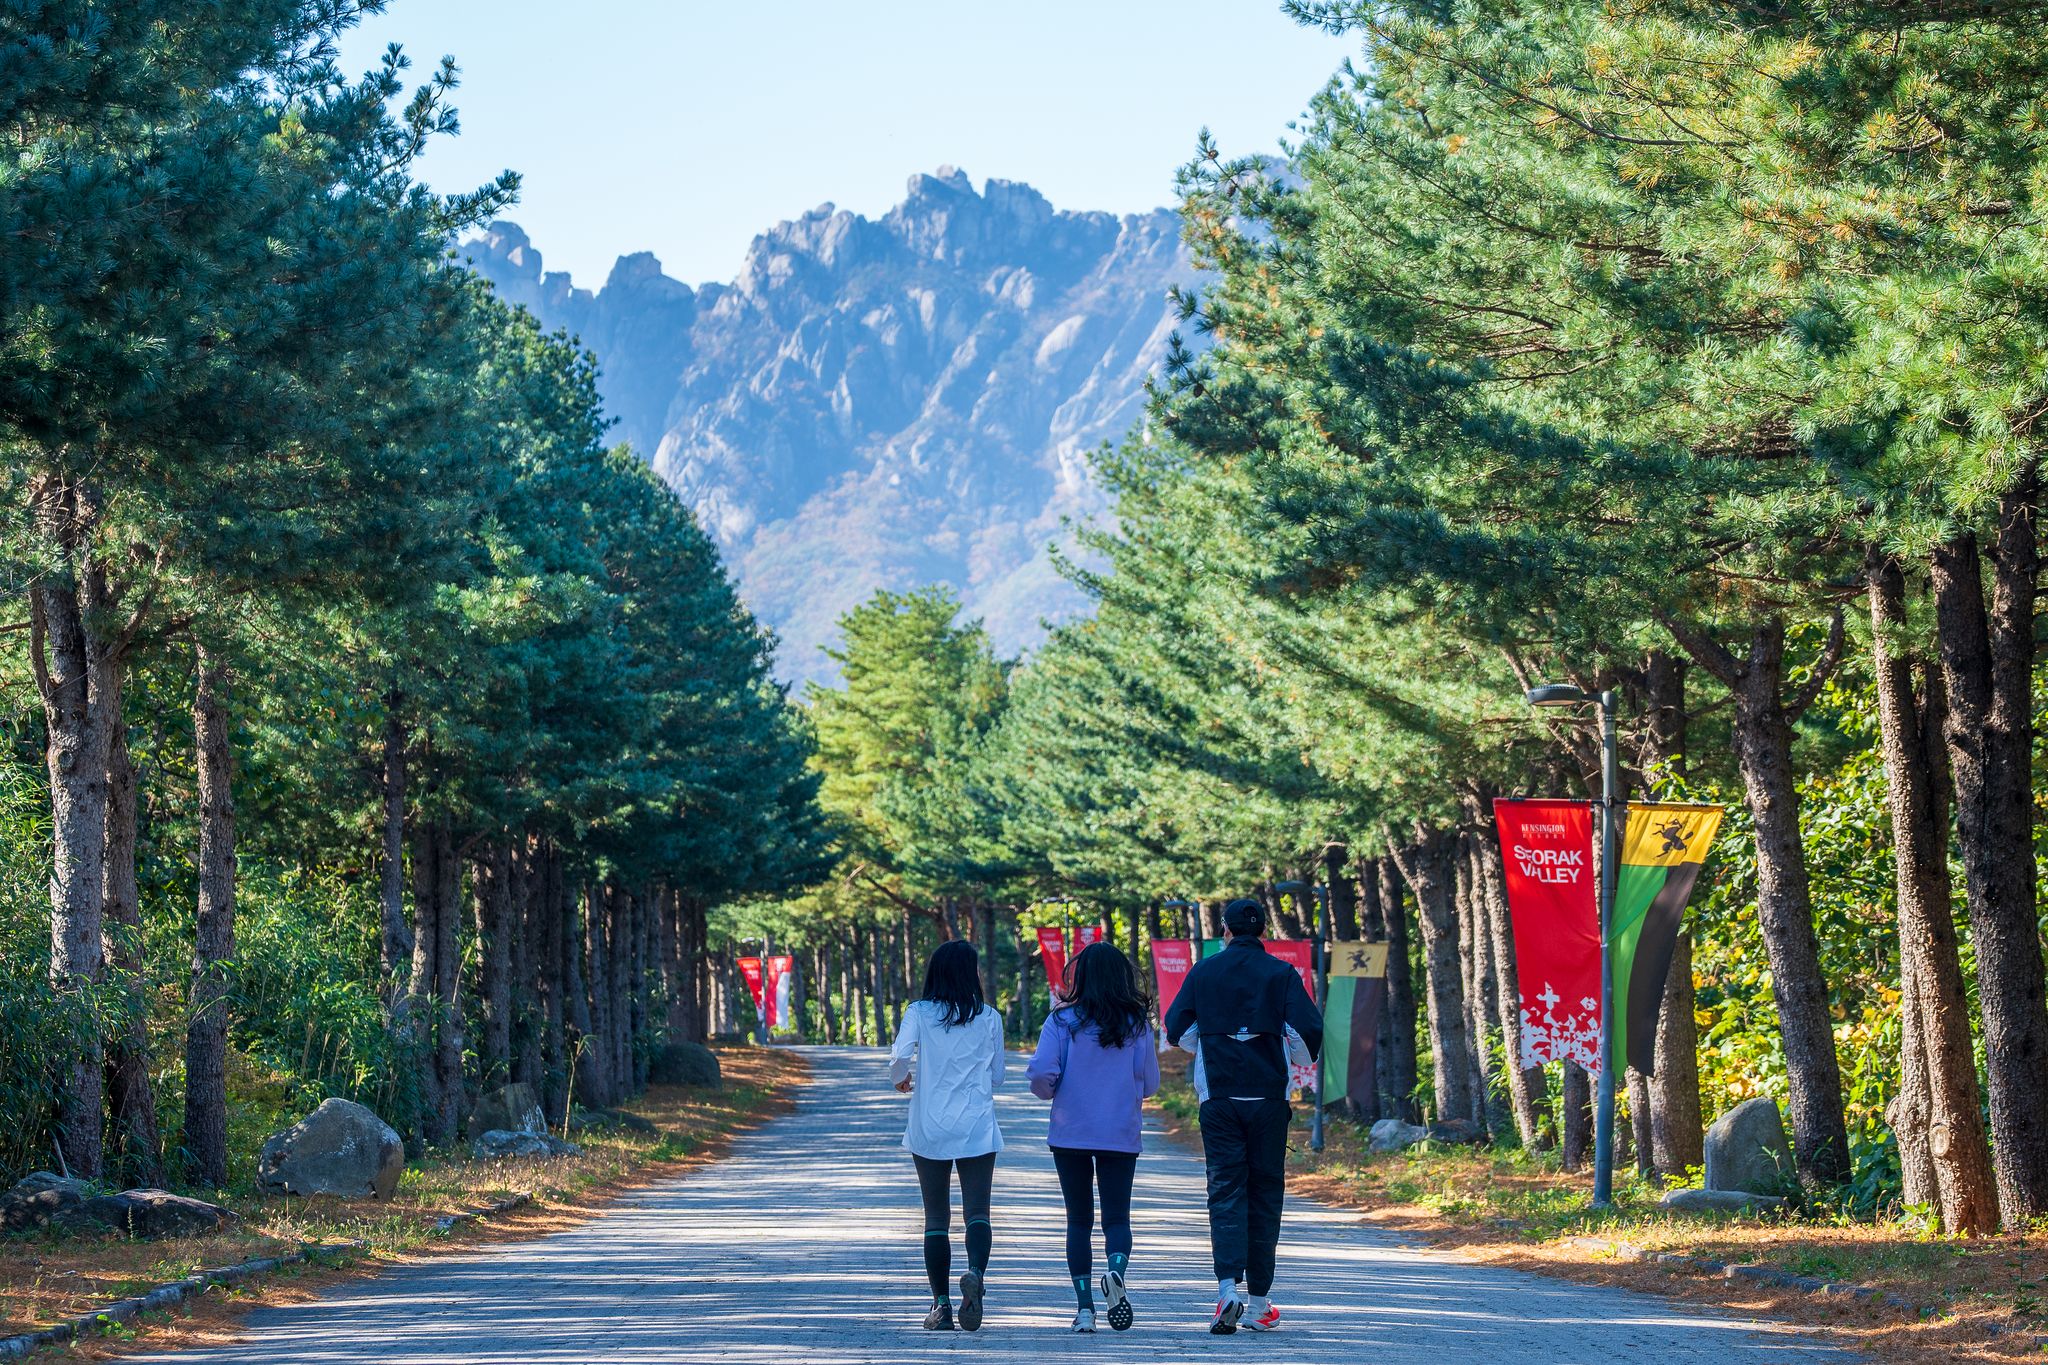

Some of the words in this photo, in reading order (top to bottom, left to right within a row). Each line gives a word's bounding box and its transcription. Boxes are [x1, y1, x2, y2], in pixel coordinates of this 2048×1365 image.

[1521, 824, 1565, 833] KENSINGTON
[1514, 845, 1583, 866] SEORAK
[1519, 862, 1580, 884] VALLEY
